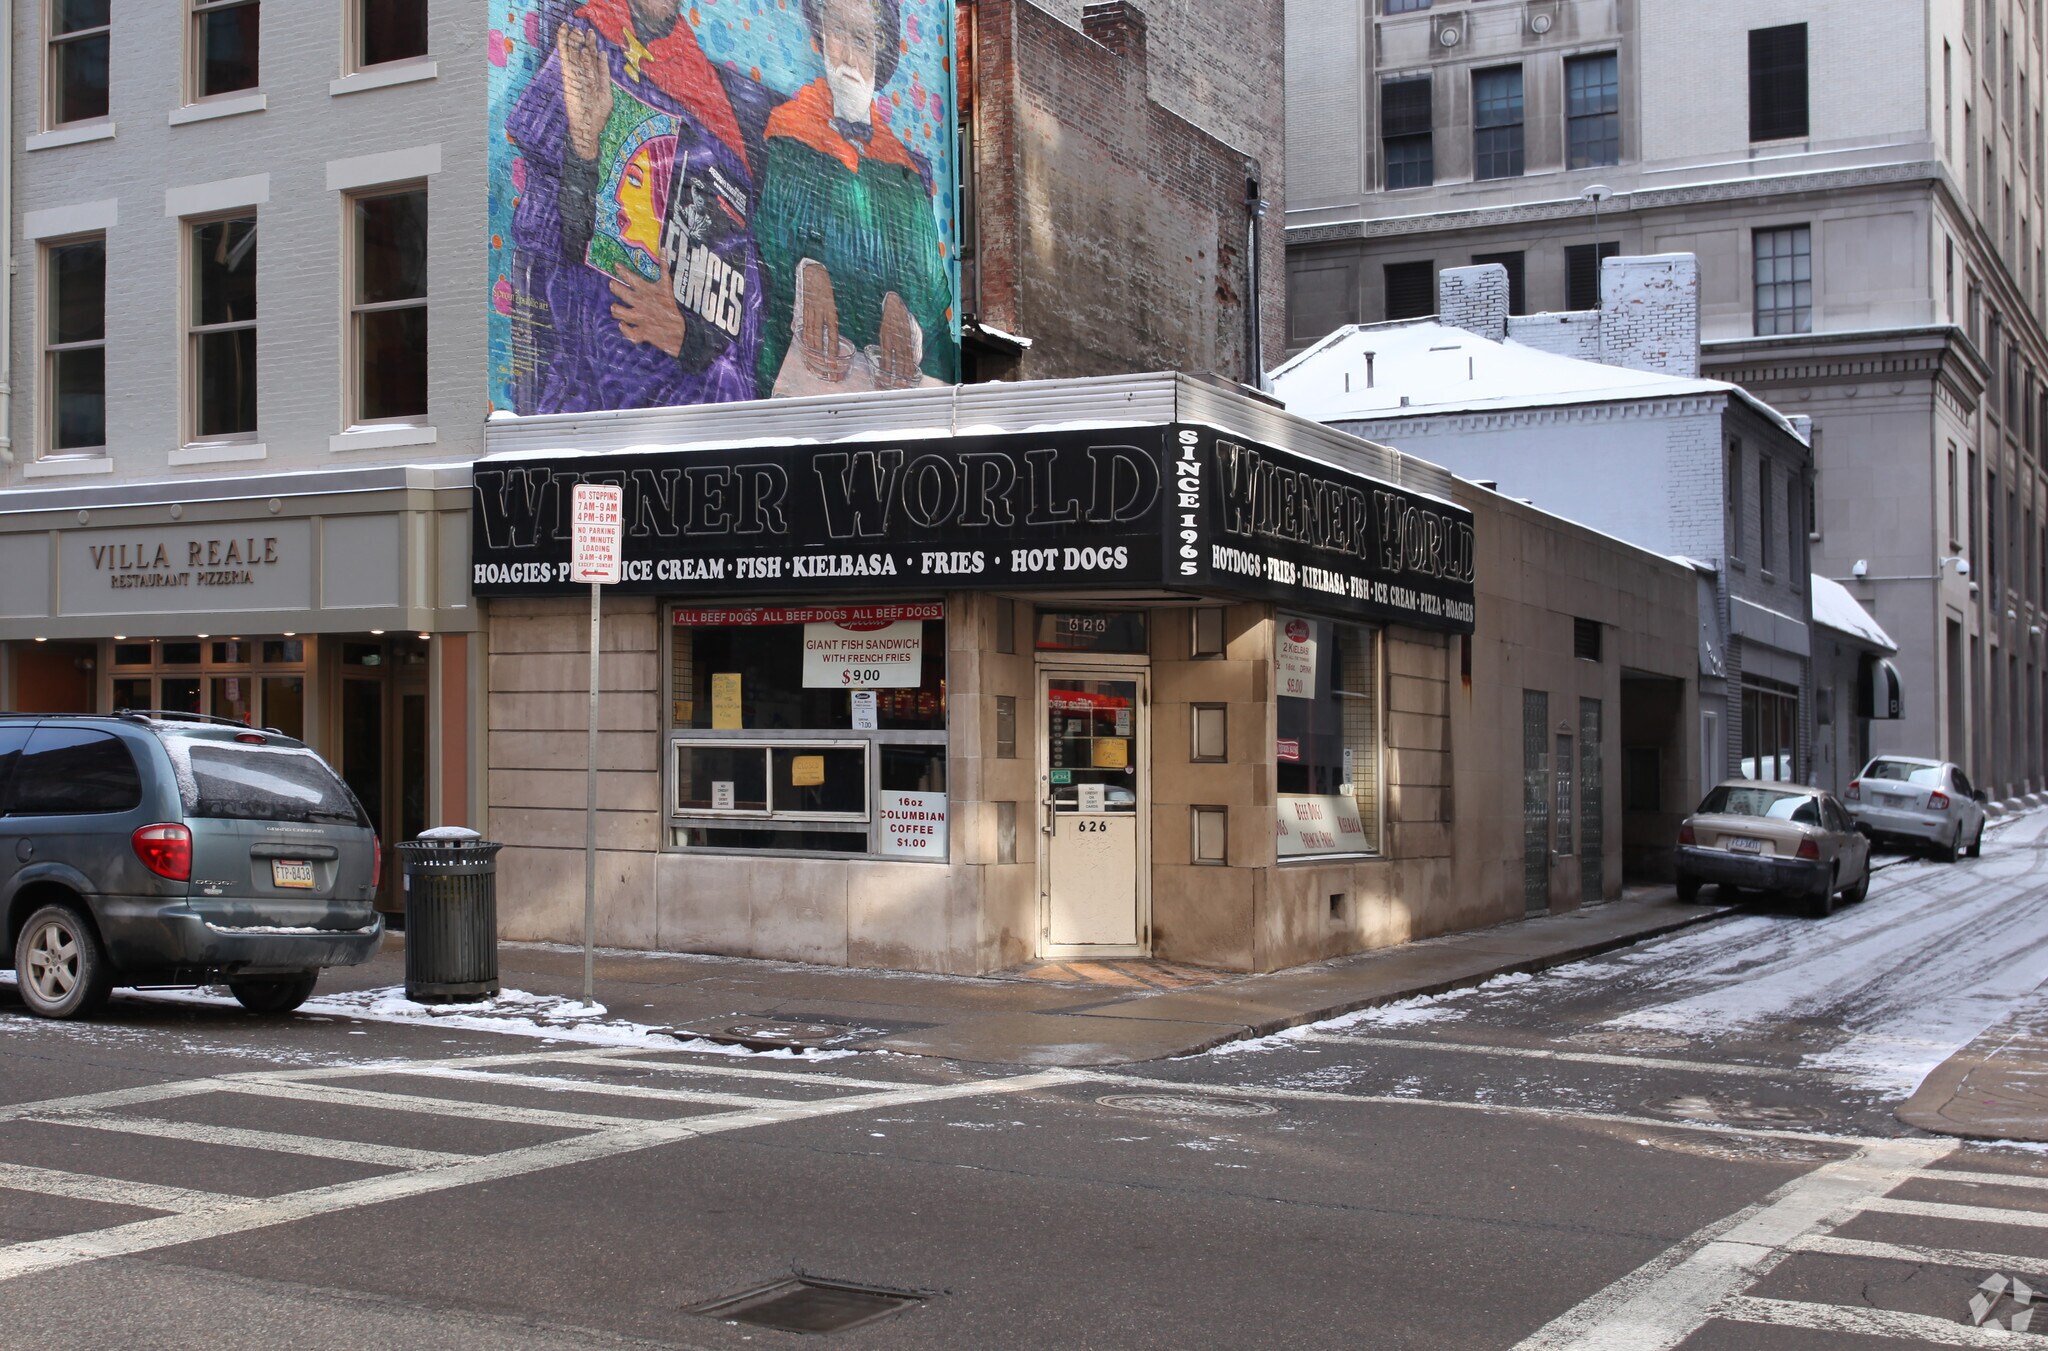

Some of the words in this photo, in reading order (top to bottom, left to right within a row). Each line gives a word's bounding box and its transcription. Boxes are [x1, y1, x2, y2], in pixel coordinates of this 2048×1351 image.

[664, 219, 744, 337] FENCES
[1176, 430, 1201, 509] SINCE
[473, 463, 788, 549] WINER
[813, 444, 1160, 538] WORLD
[578, 491, 586, 499] NO
[588, 491, 617, 501] STOPPING
[1216, 438, 1367, 560] WIENER
[1373, 489, 1477, 584] WORLD
[1179, 514, 1199, 576] 1965
[89, 543, 170, 571] VILLA
[188, 537, 279, 567] REALE
[474, 562, 551, 584] HOAGIES
[621, 559, 653, 581] ICE
[656, 557, 724, 581] CREAM
[736, 555, 787, 579] FISH
[792, 553, 897, 577] KIELBASA
[921, 551, 985, 574] FRIES
[1011, 548, 1058, 572] HOT
[1063, 546, 1128, 570] DOGS
[111, 571, 190, 588] RESTAURANT
[197, 569, 255, 586] PIZZERIA
[1267, 557, 1296, 585] FRIES
[1302, 566, 1346, 596] KIELBASA
[1350, 576, 1369, 599] FISH
[1374, 582, 1388, 603] ICE
[1390, 584, 1416, 610] CREAM
[1420, 593, 1441, 616] PIZZA
[1446, 596, 1474, 623] HOAGIES
[678, 612, 698, 622] ALL
[701, 612, 726, 622] BEEF
[729, 611, 758, 622] DOGS
[762, 611, 783, 621] ALL
[786, 610, 814, 621] BEEF
[816, 610, 847, 620] DOGS
[852, 609, 873, 619] ALL
[876, 607, 904, 618] BEEF
[906, 606, 938, 617] DOGS
[1070, 619, 1105, 631] 626
[806, 639, 838, 650] GIANT
[841, 639, 864, 650] FISH
[866, 638, 920, 650] SANDWICH
[822, 654, 846, 663] WITH
[847, 653, 884, 662] FRENCH
[885, 653, 911, 662] FRIES
[898, 798, 923, 807] 16oz
[880, 811, 945, 821] COLUMBIAN
[890, 824, 934, 835] COFFEE
[1078, 821, 1107, 832] 626
[896, 838, 926, 848] $1.00
